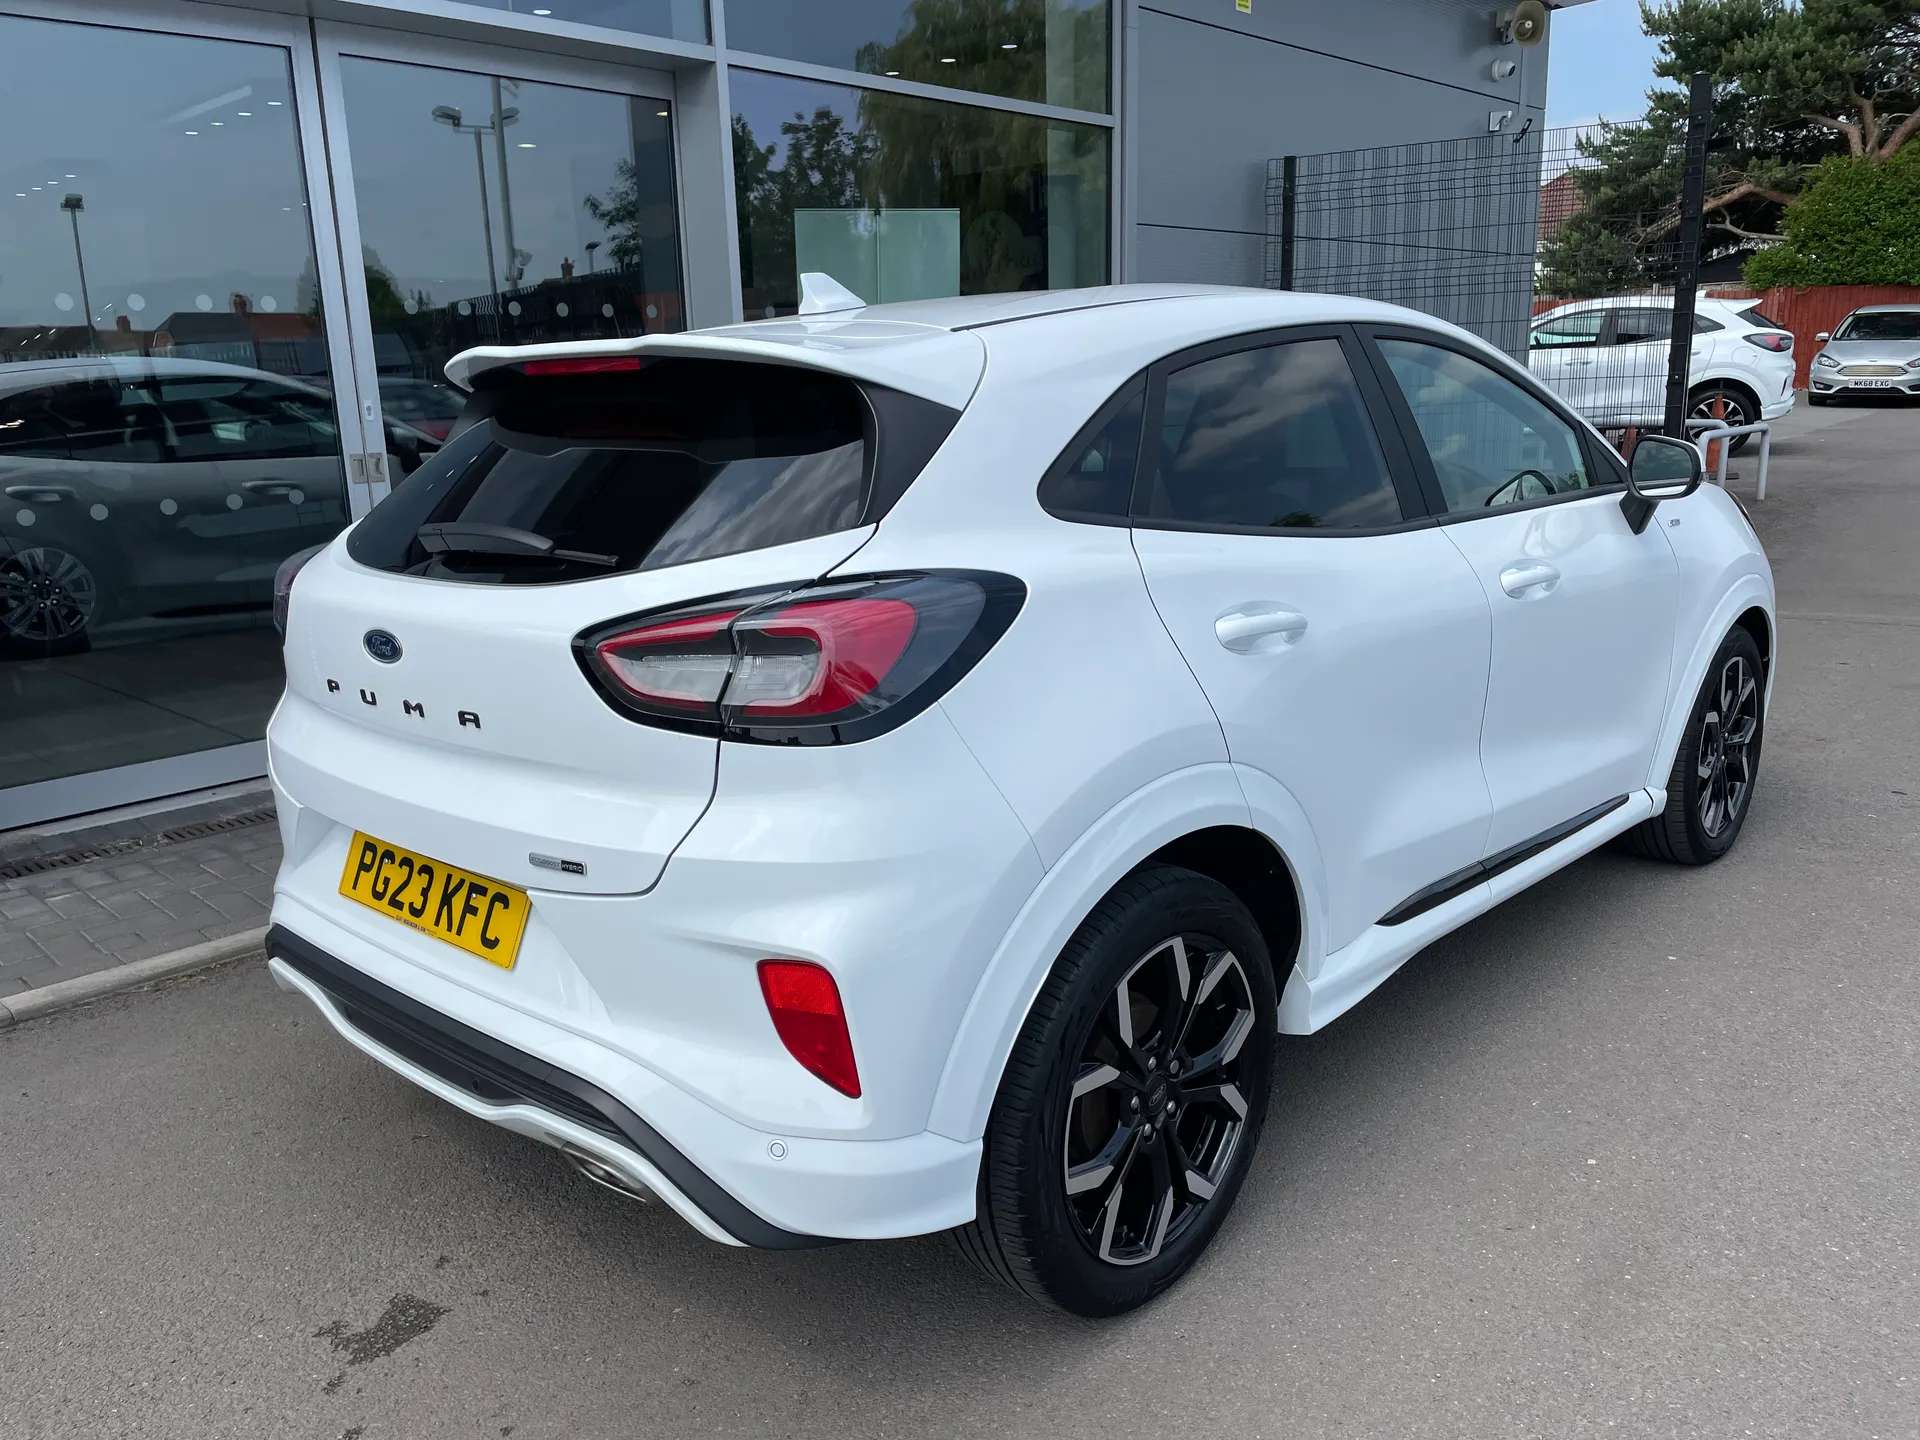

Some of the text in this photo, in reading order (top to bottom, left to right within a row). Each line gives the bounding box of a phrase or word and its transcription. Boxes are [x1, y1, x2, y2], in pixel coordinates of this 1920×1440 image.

[326, 678, 482, 729] PUMA
[352, 840, 511, 950] PG23 KFC
